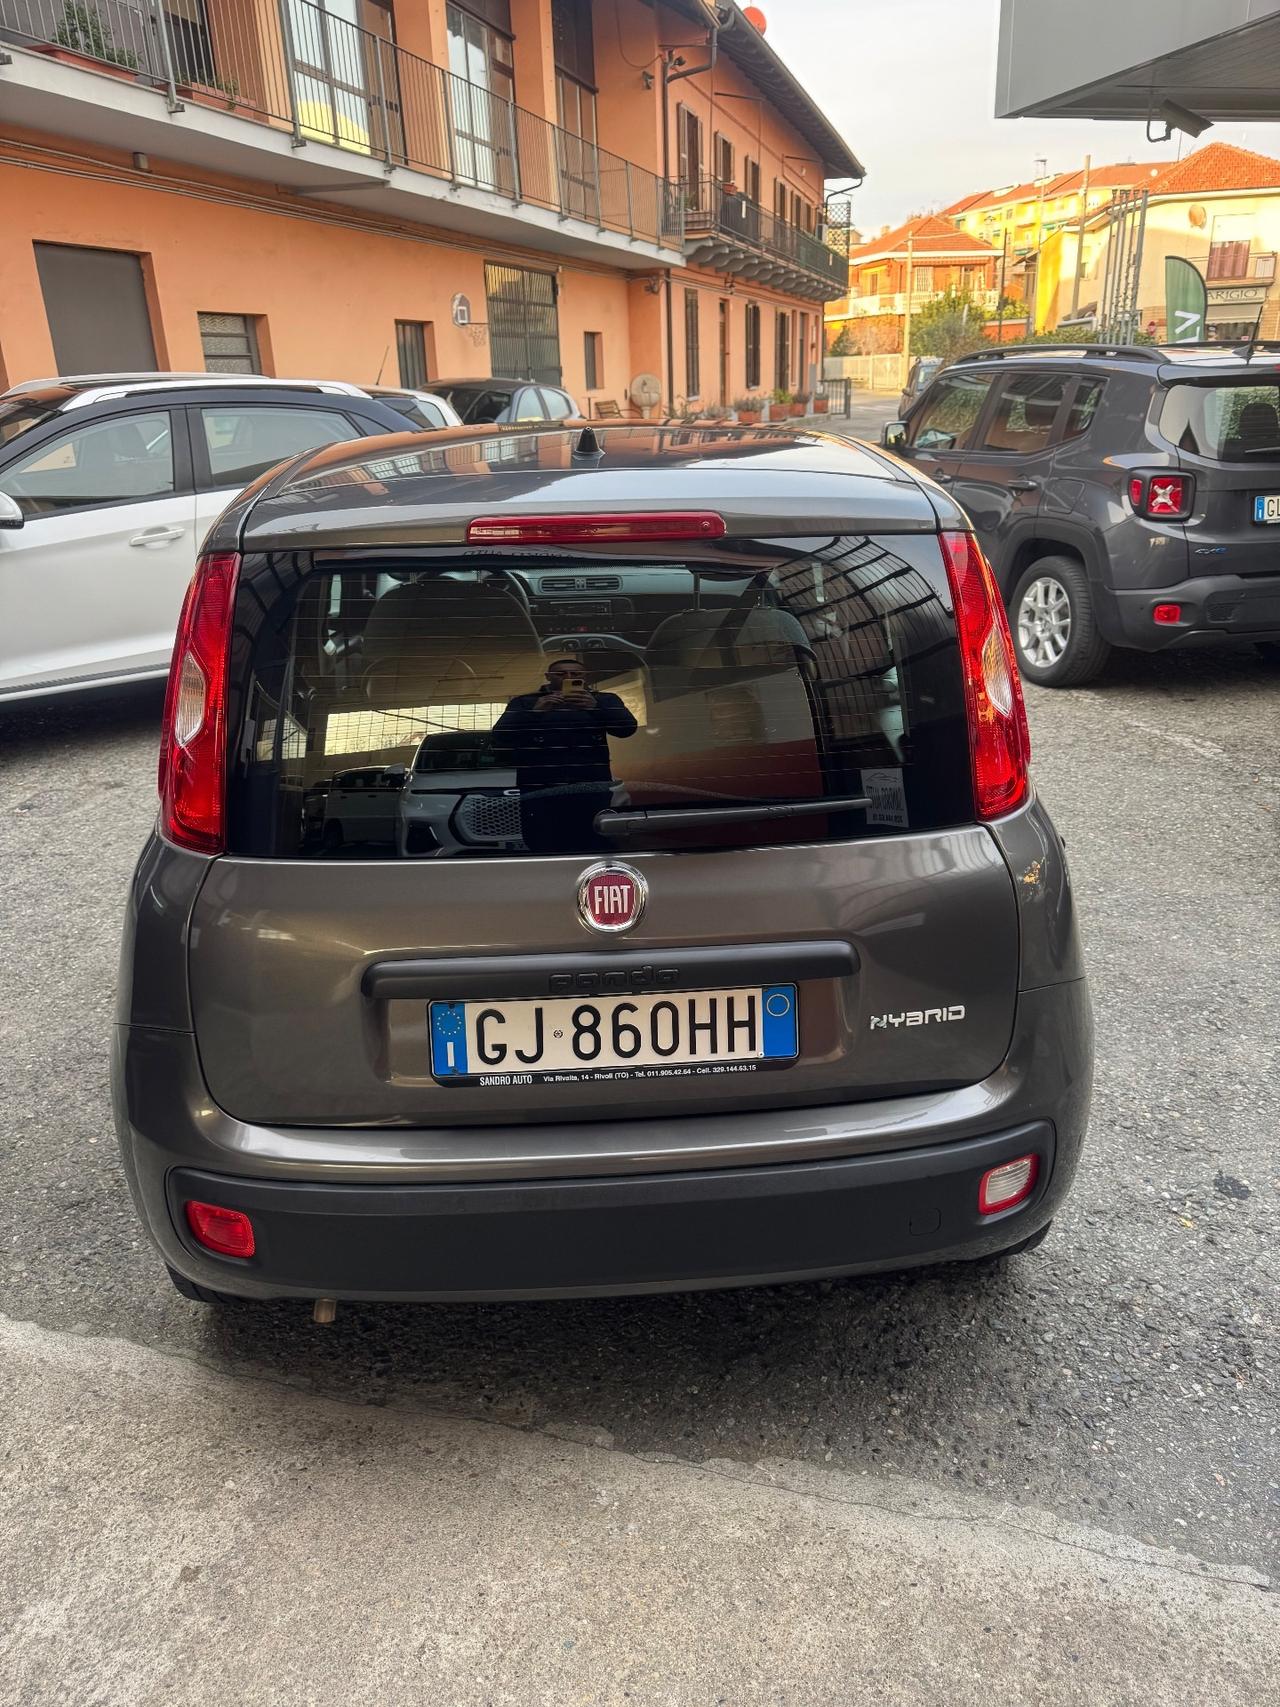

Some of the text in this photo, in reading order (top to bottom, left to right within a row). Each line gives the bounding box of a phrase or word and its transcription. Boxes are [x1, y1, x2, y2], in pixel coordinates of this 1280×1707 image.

[594, 885, 631, 915] FIAT
[476, 995, 757, 1065] GJ 860HH
[870, 1005, 966, 1030] HYBRID
[479, 1074, 533, 1087] SANDRO AUTO
[594, 1072, 613, 1080] Rivoli
[614, 1071, 629, 1080] (TO)
[696, 1067, 711, 1075] Cell.
